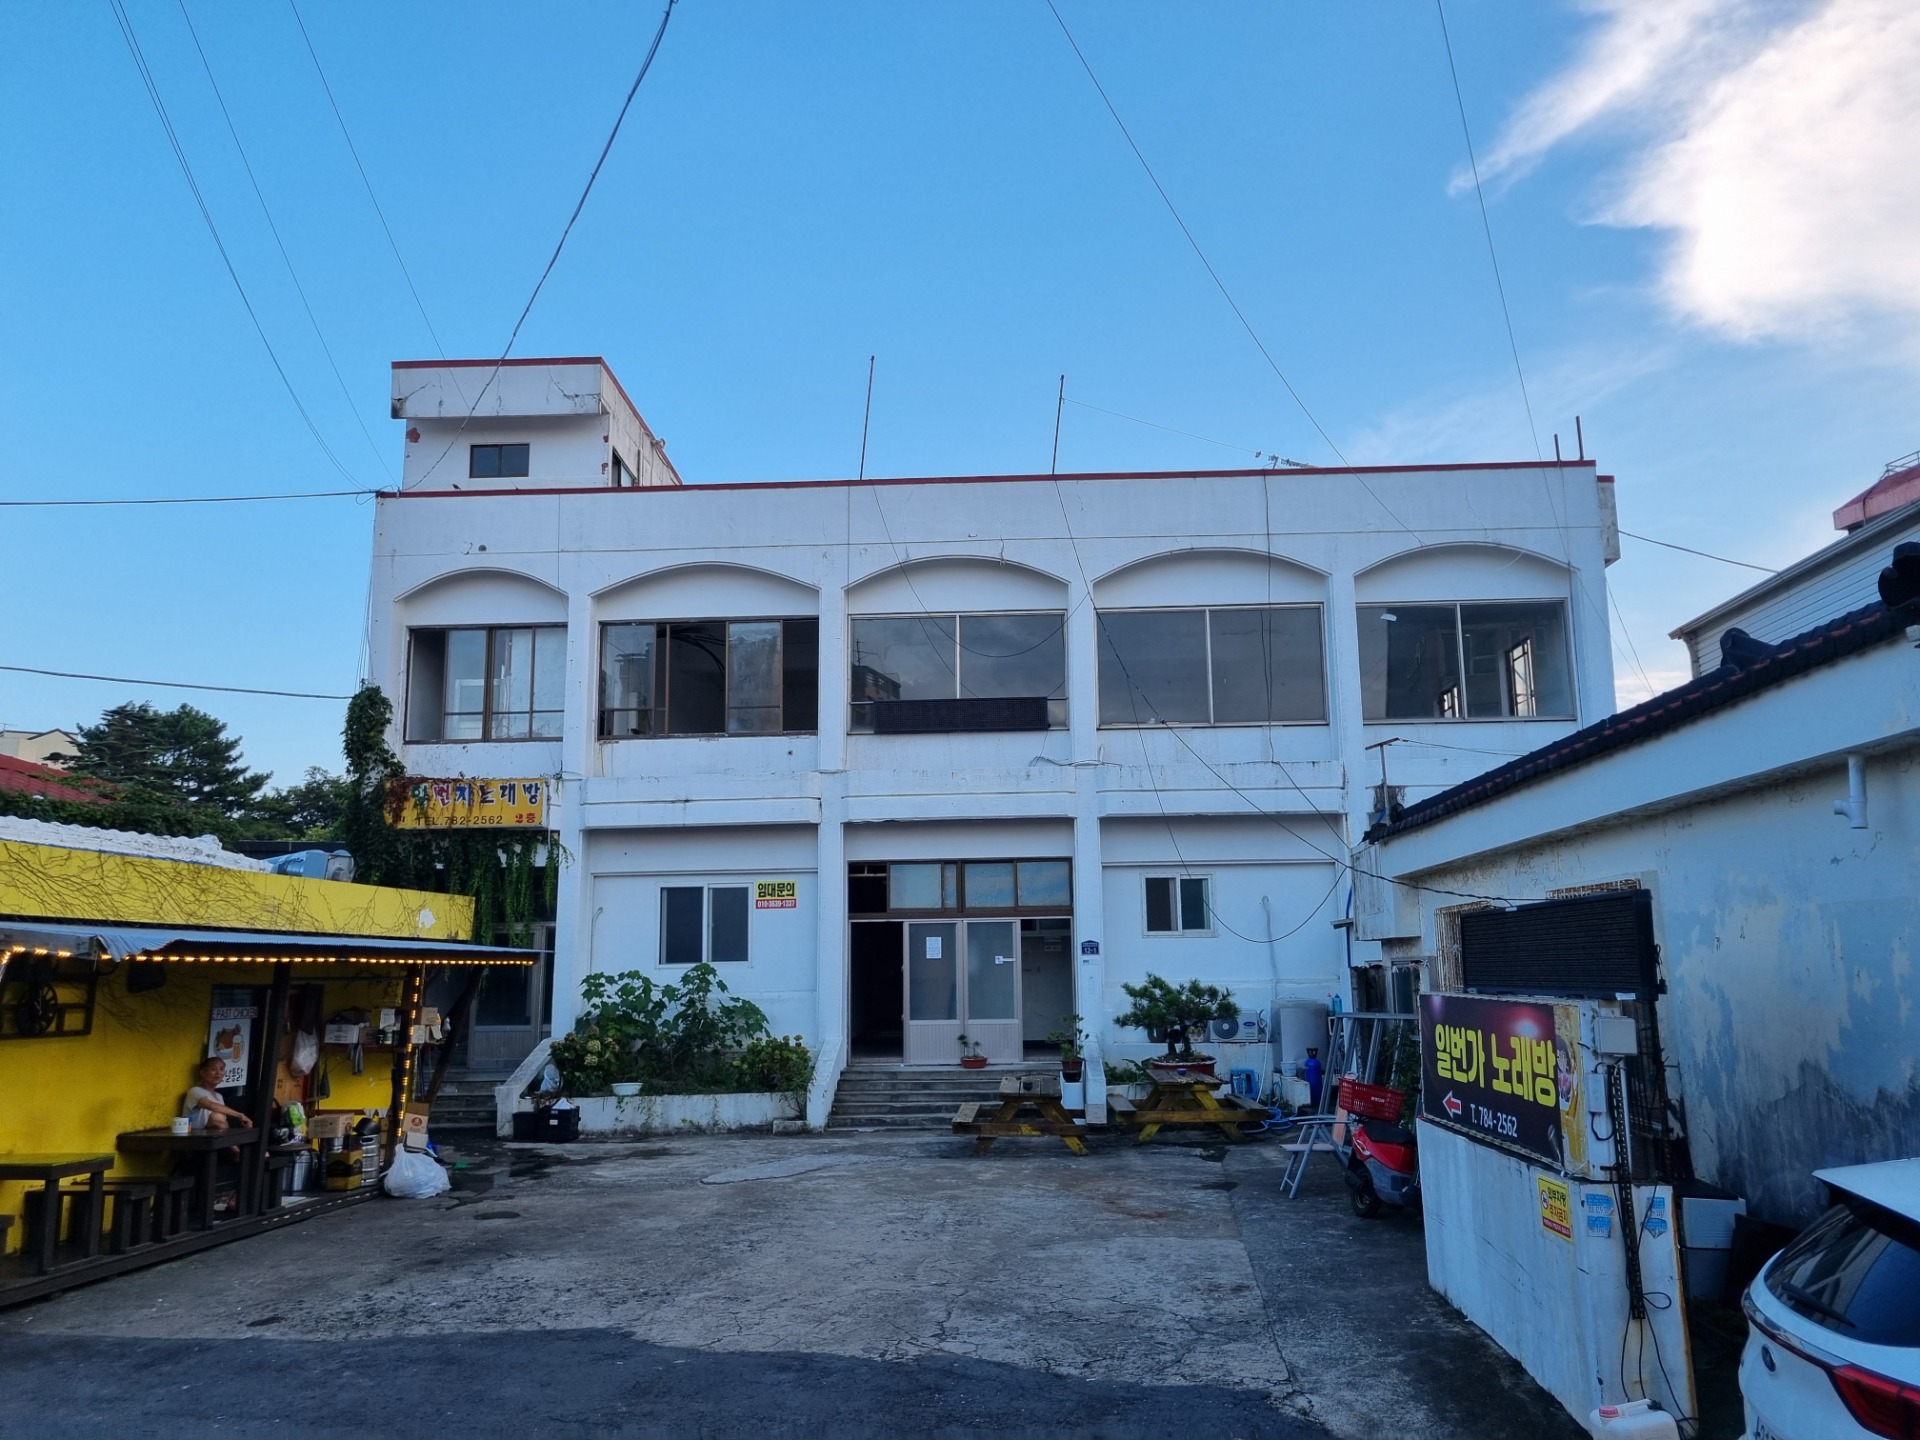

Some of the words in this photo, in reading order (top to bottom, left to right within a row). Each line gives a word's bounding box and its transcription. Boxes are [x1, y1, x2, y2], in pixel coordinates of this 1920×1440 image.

[515, 812, 536, 824] 2층
[757, 882, 795, 898] 임대문의
[1435, 1023, 1485, 1089] 일번가
[1491, 1032, 1556, 1108] 노래방
